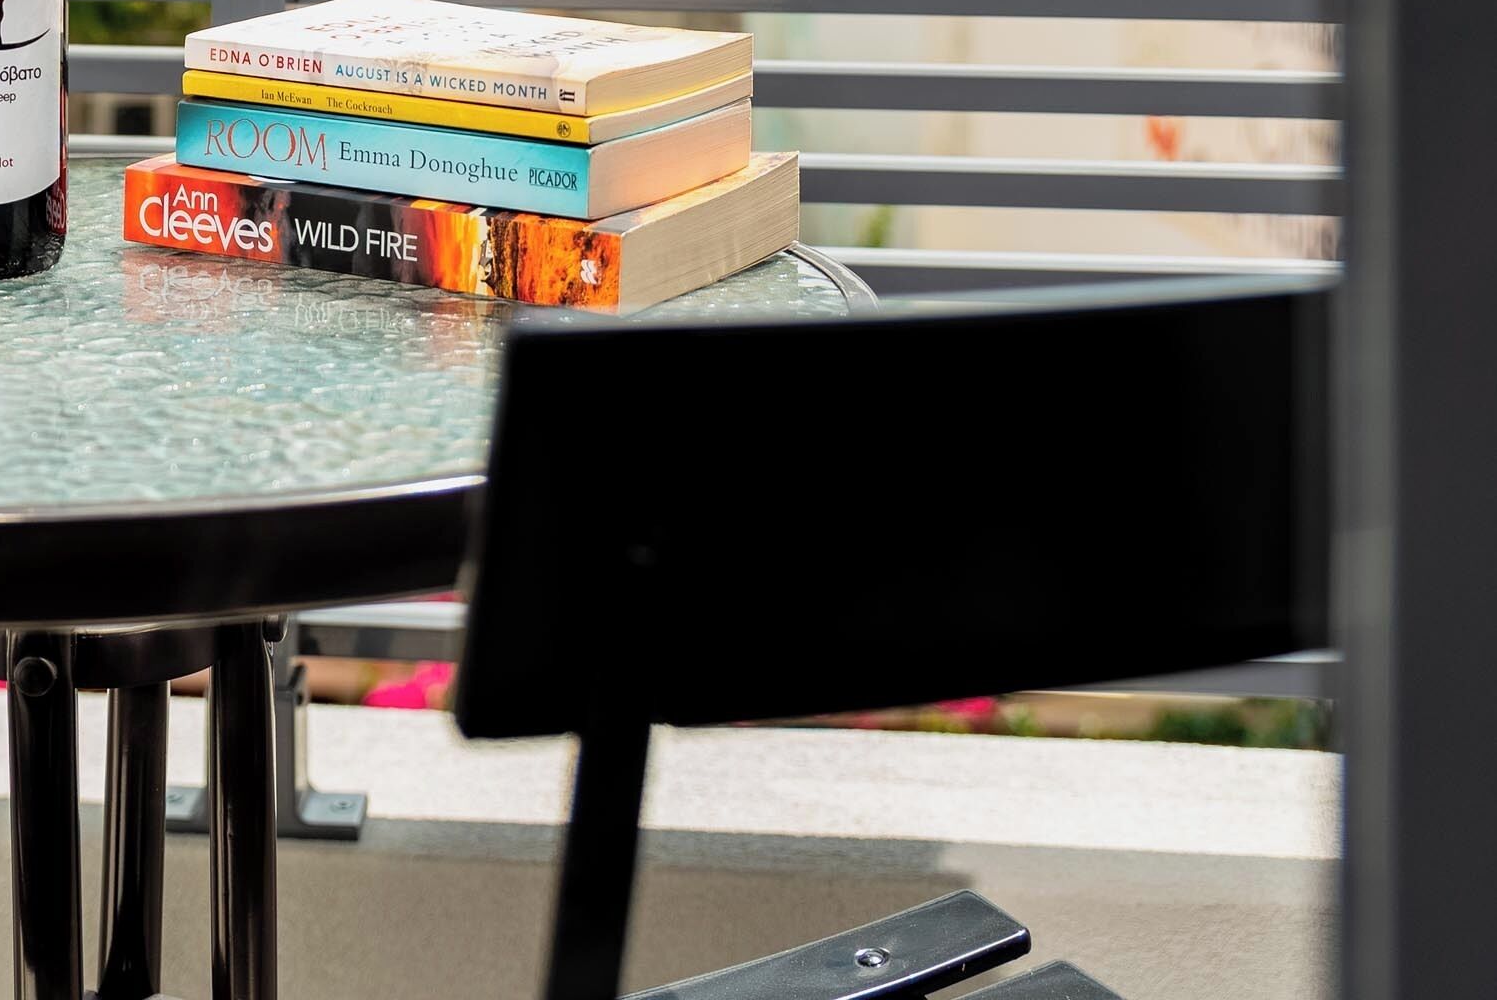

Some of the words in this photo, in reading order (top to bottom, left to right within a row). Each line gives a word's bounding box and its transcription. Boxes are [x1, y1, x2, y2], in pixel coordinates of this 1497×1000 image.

[210, 48, 251, 65] EDNA
[258, 54, 322, 74] O'BRIEN
[335, 64, 390, 81] AUGUST
[396, 71, 408, 83] IS
[414, 71, 423, 85] A
[429, 75, 486, 92] WICKED
[494, 83, 547, 99] MONTH
[261, 89, 274, 100] Ian
[277, 91, 312, 105] McEwan
[326, 96, 343, 108] The
[345, 99, 393, 115] Cockroach
[204, 118, 328, 171] ROOM
[338, 141, 400, 168] Emma
[409, 149, 518, 183] Donoghue
[528, 167, 578, 191] PICADOR
[172, 183, 218, 213] Ann
[139, 192, 274, 253] Cleeves
[295, 218, 359, 253] WILD
[366, 228, 418, 262] FIRE
